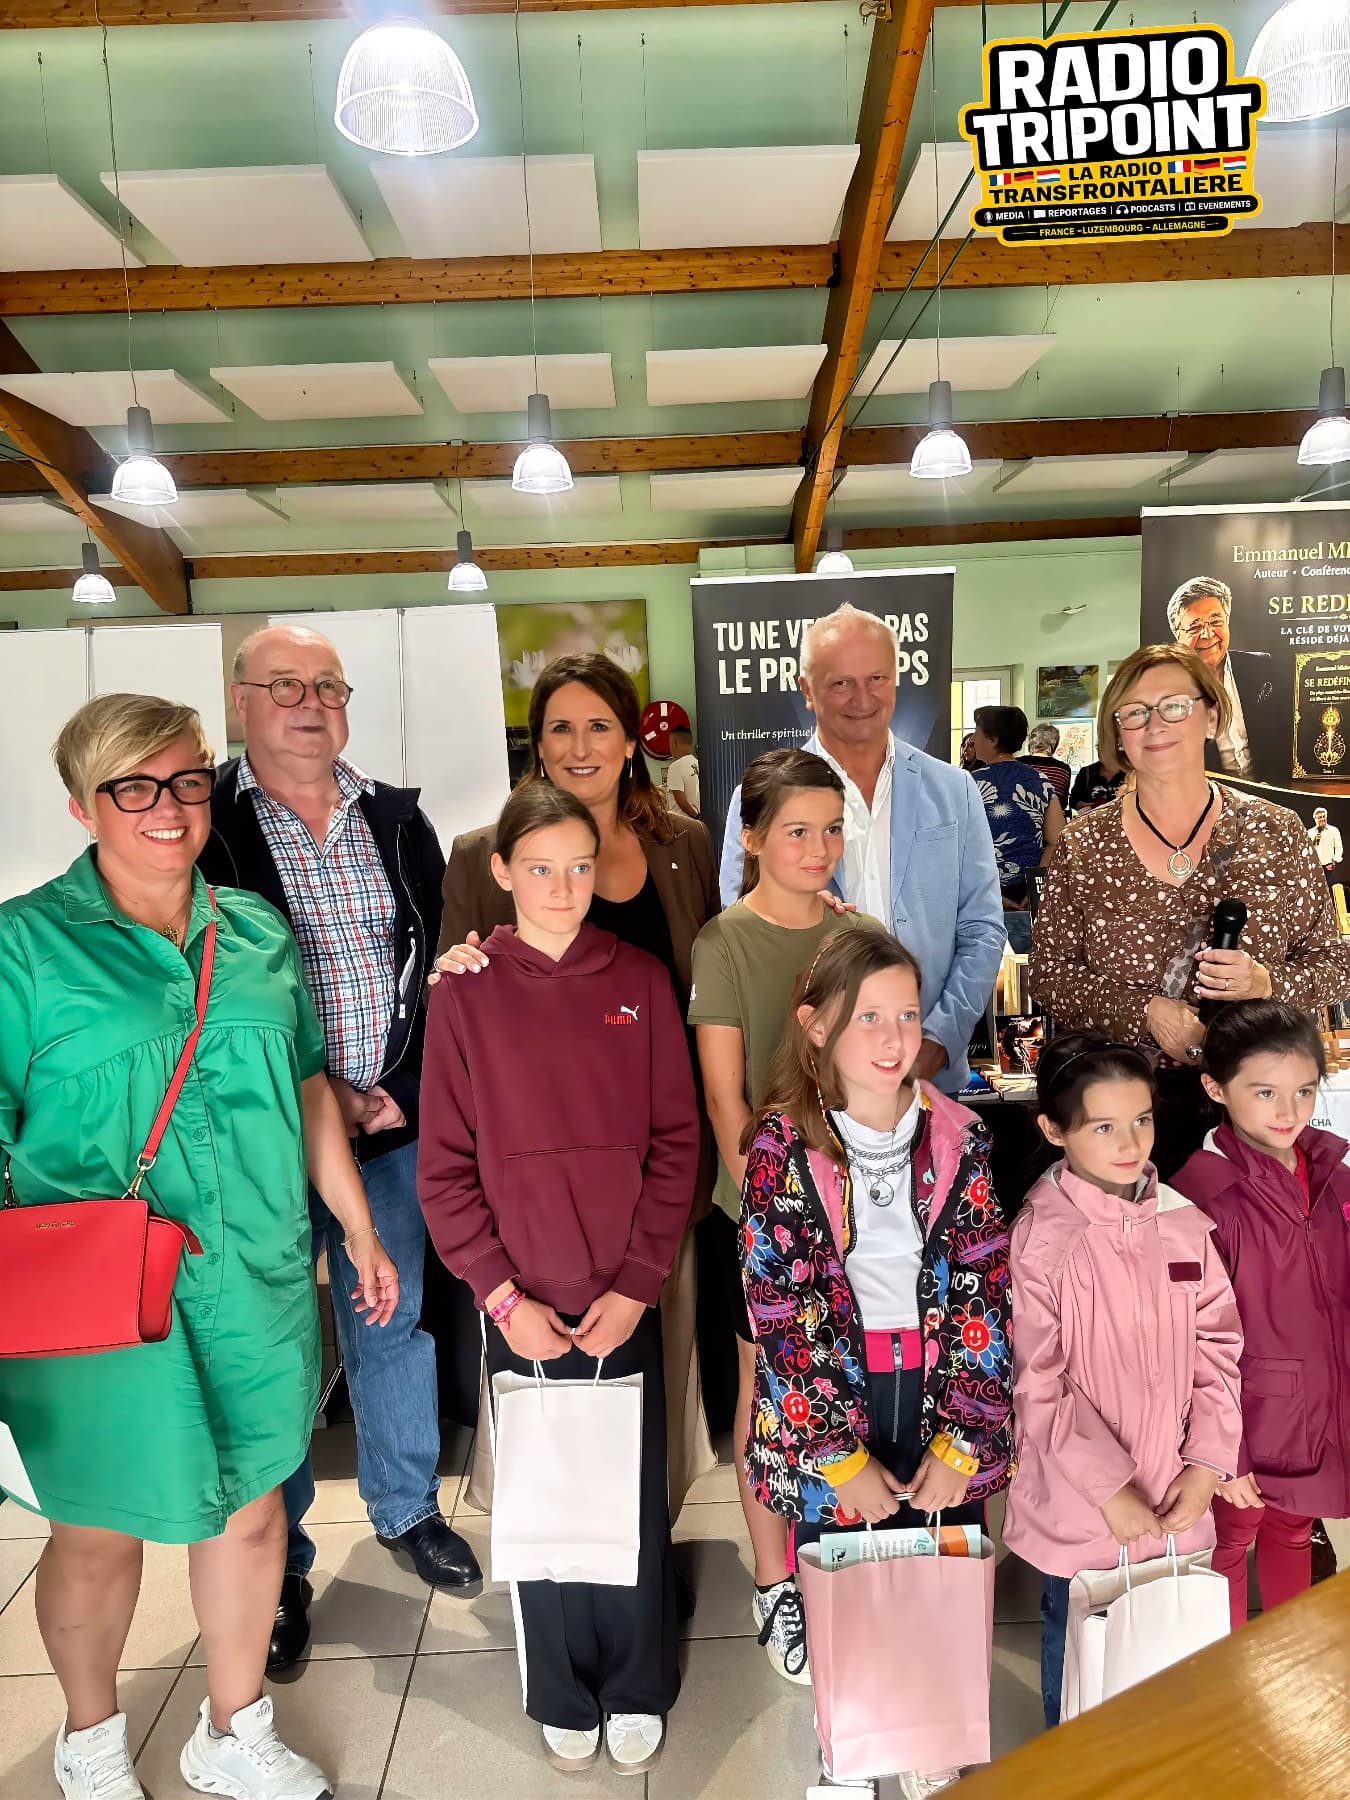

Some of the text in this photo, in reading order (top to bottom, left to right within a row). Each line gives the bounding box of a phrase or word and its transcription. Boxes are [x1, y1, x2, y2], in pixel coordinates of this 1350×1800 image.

[1231, 541, 1324, 563] Emmanuel
[1253, 568, 1289, 579] Auteur
[1268, 596, 1294, 615] SE
[713, 622, 744, 652] TU
[750, 620, 780, 650] NE
[1280, 627, 1293, 635] LA
[1295, 624, 1314, 635] CLÉ
[1317, 624, 1330, 634] DE
[1289, 636, 1324, 646] RÉSIDE
[718, 657, 752, 695] LE
[1304, 678, 1315, 688] SE
[721, 725, 814, 742] Un thriller spirituel
